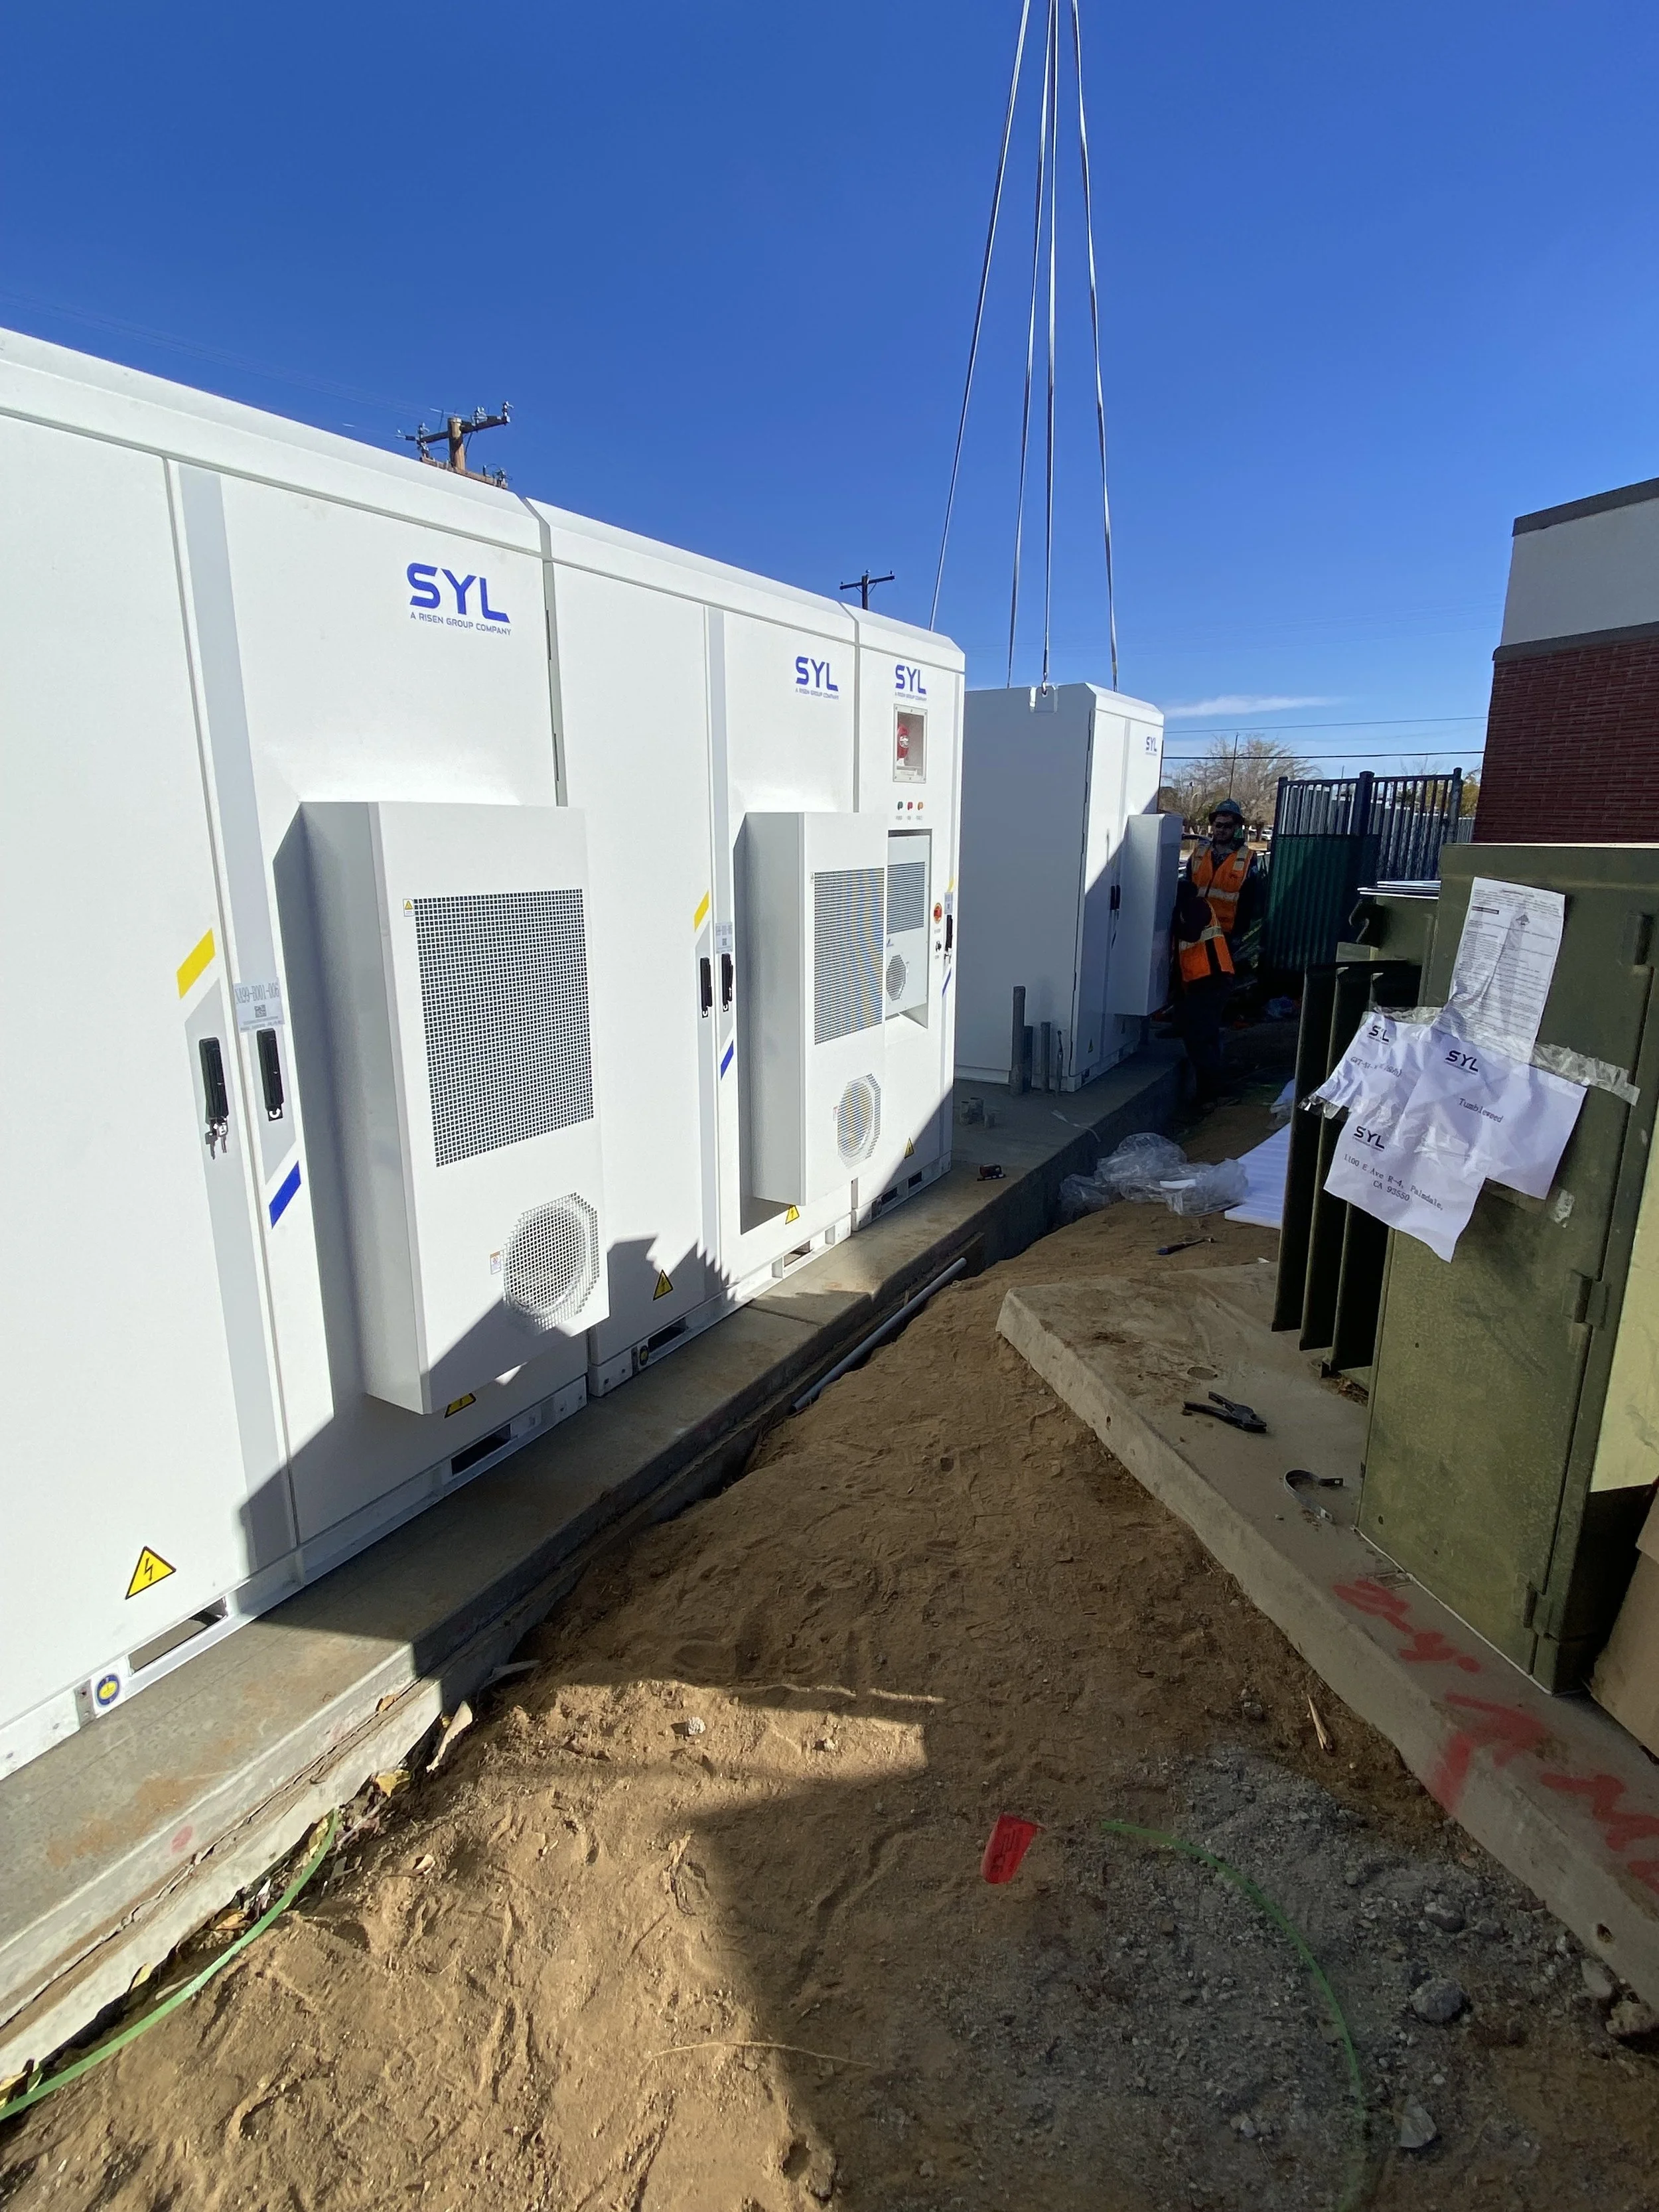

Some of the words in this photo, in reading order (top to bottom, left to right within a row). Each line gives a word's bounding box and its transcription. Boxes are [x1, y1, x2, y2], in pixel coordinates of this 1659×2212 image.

[407, 562, 510, 623] SYL
[410, 611, 416, 620] A
[419, 613, 444, 624] RISEN
[446, 617, 474, 629] GROUP
[476, 623, 512, 636] COMPANY
[795, 656, 839, 692] SYL
[895, 664, 927, 695] SYL
[1145, 736, 1157, 752] SYL
[1368, 1025, 1390, 1042] SL
[1445, 1049, 1479, 1072] SYL
[1354, 1125, 1385, 1149] SYL
[1370, 1167, 1384, 1179] Ave
[1373, 1180, 1383, 1189] CA
[1386, 1186, 1410, 1201] 93550
